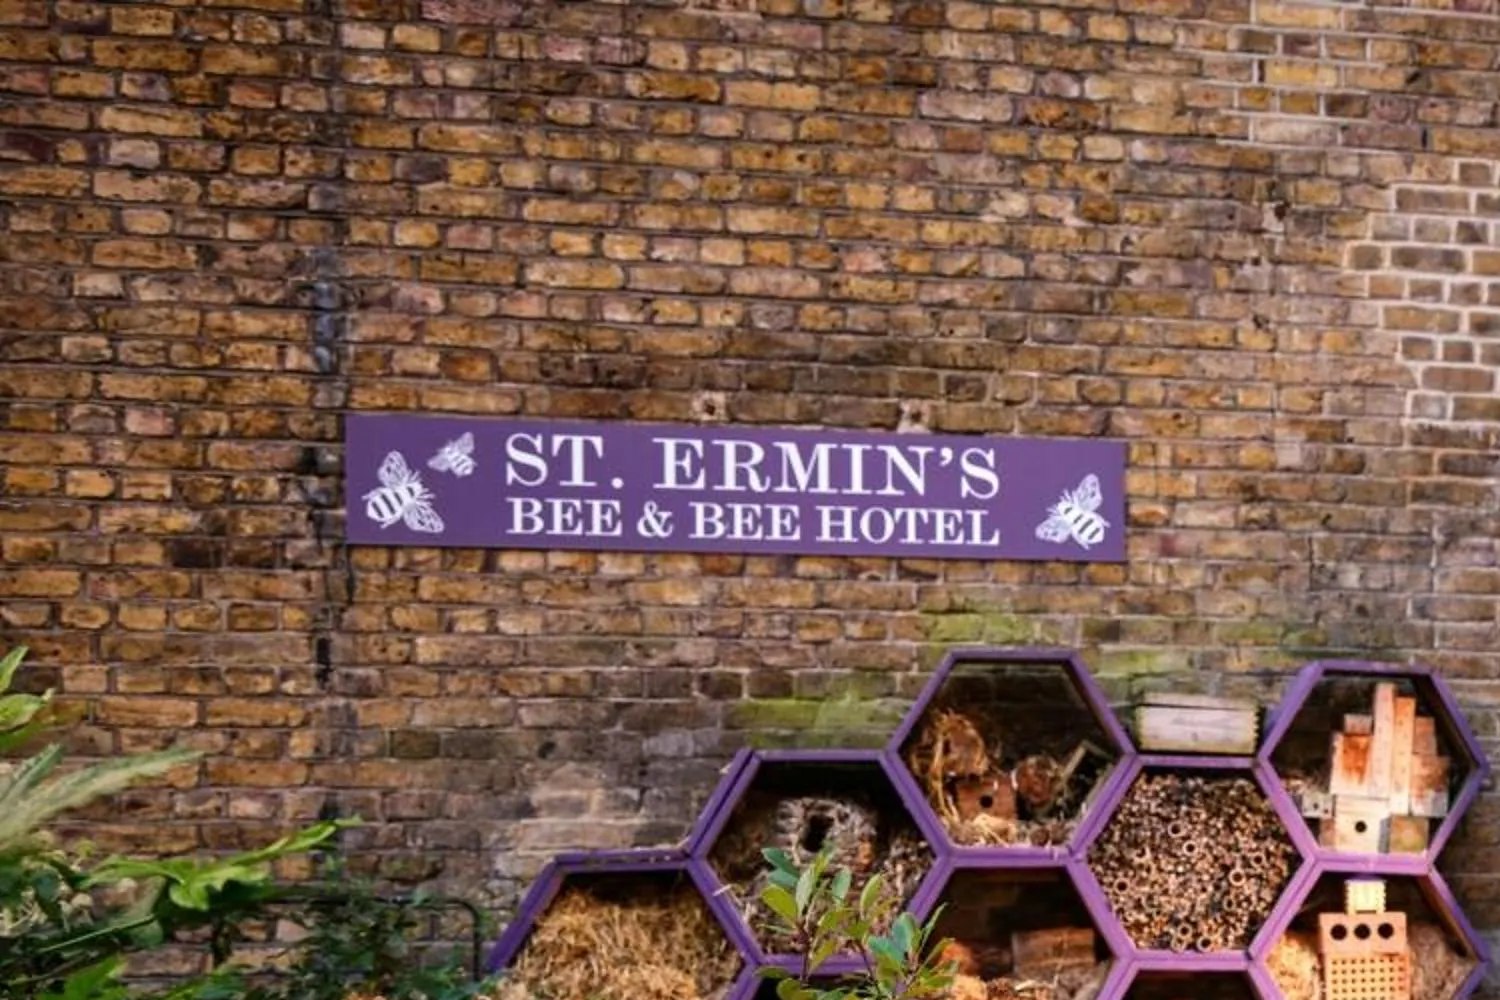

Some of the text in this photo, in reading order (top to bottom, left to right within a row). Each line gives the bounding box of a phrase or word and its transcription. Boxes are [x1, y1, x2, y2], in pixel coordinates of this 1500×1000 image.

[504, 431, 1000, 499] ST. ERMIN'S
[505, 497, 1000, 547] BEE & BEE HOTEL
